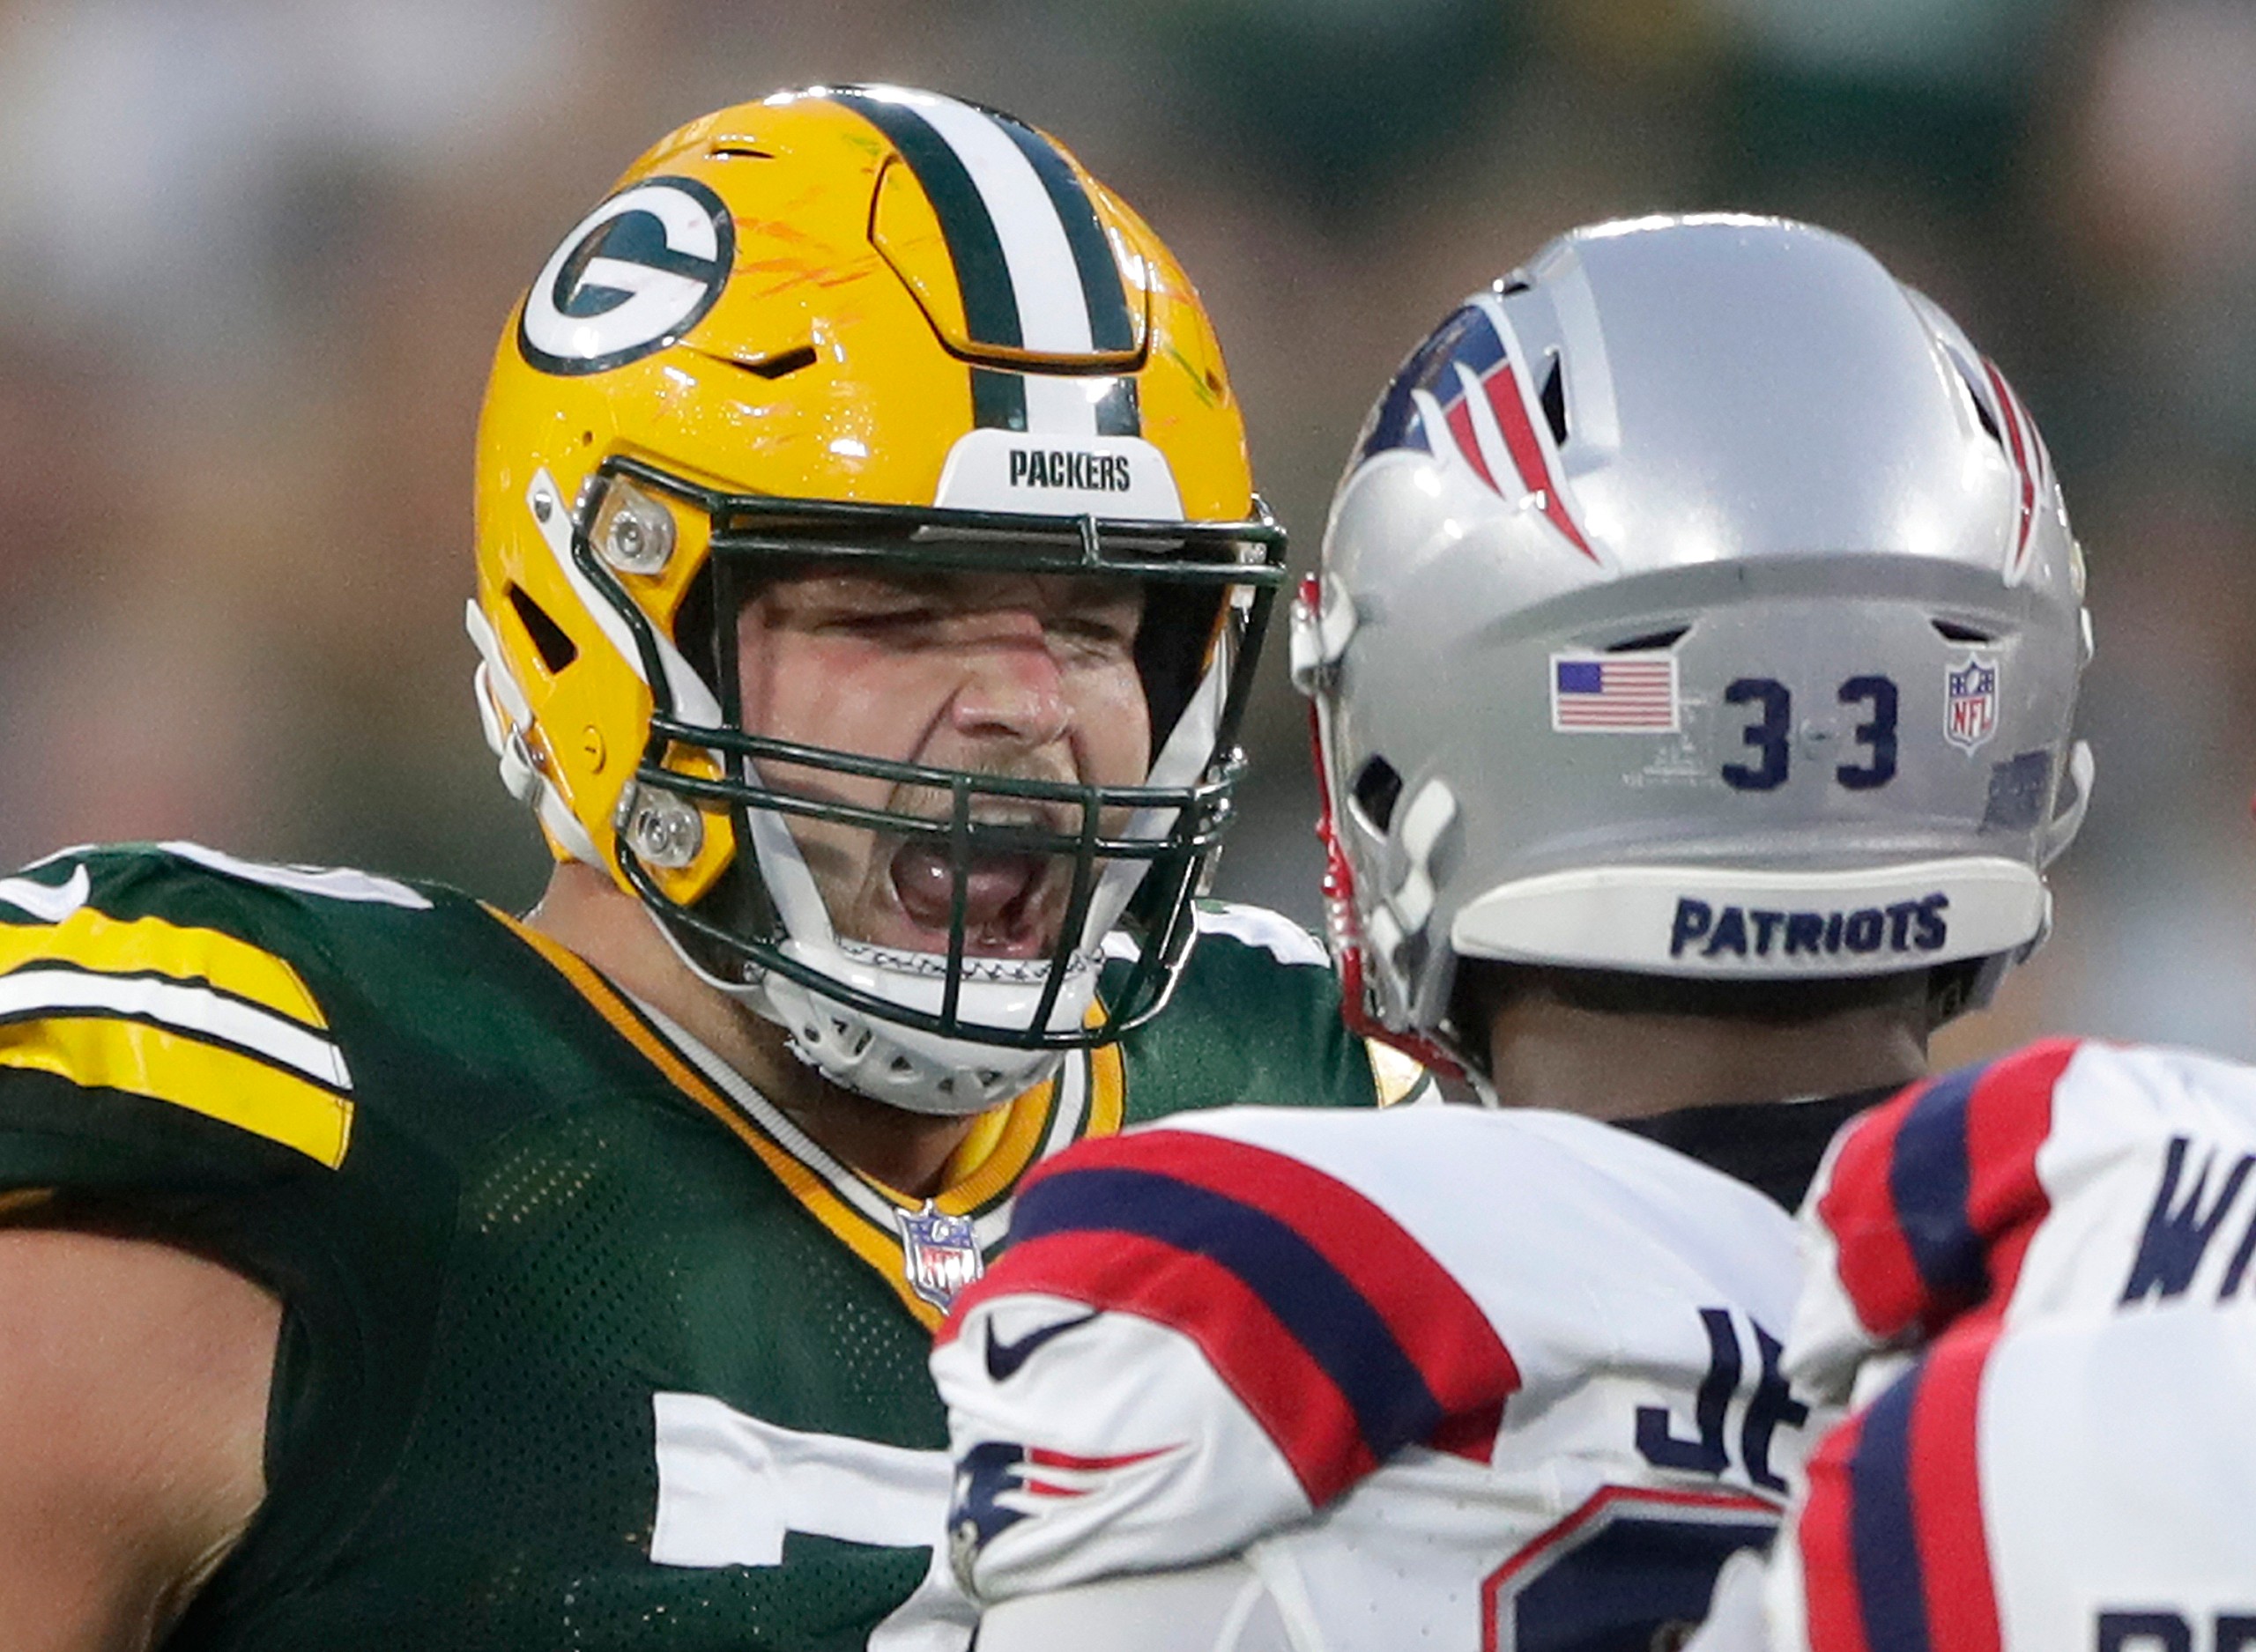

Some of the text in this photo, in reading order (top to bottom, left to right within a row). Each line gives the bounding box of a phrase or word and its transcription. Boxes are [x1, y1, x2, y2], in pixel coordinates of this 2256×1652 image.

[523, 185, 717, 359] G
[1010, 450, 1131, 492] PACKERS
[1953, 697, 1993, 737] NFL
[1670, 892, 1949, 959] PATRIOTS
